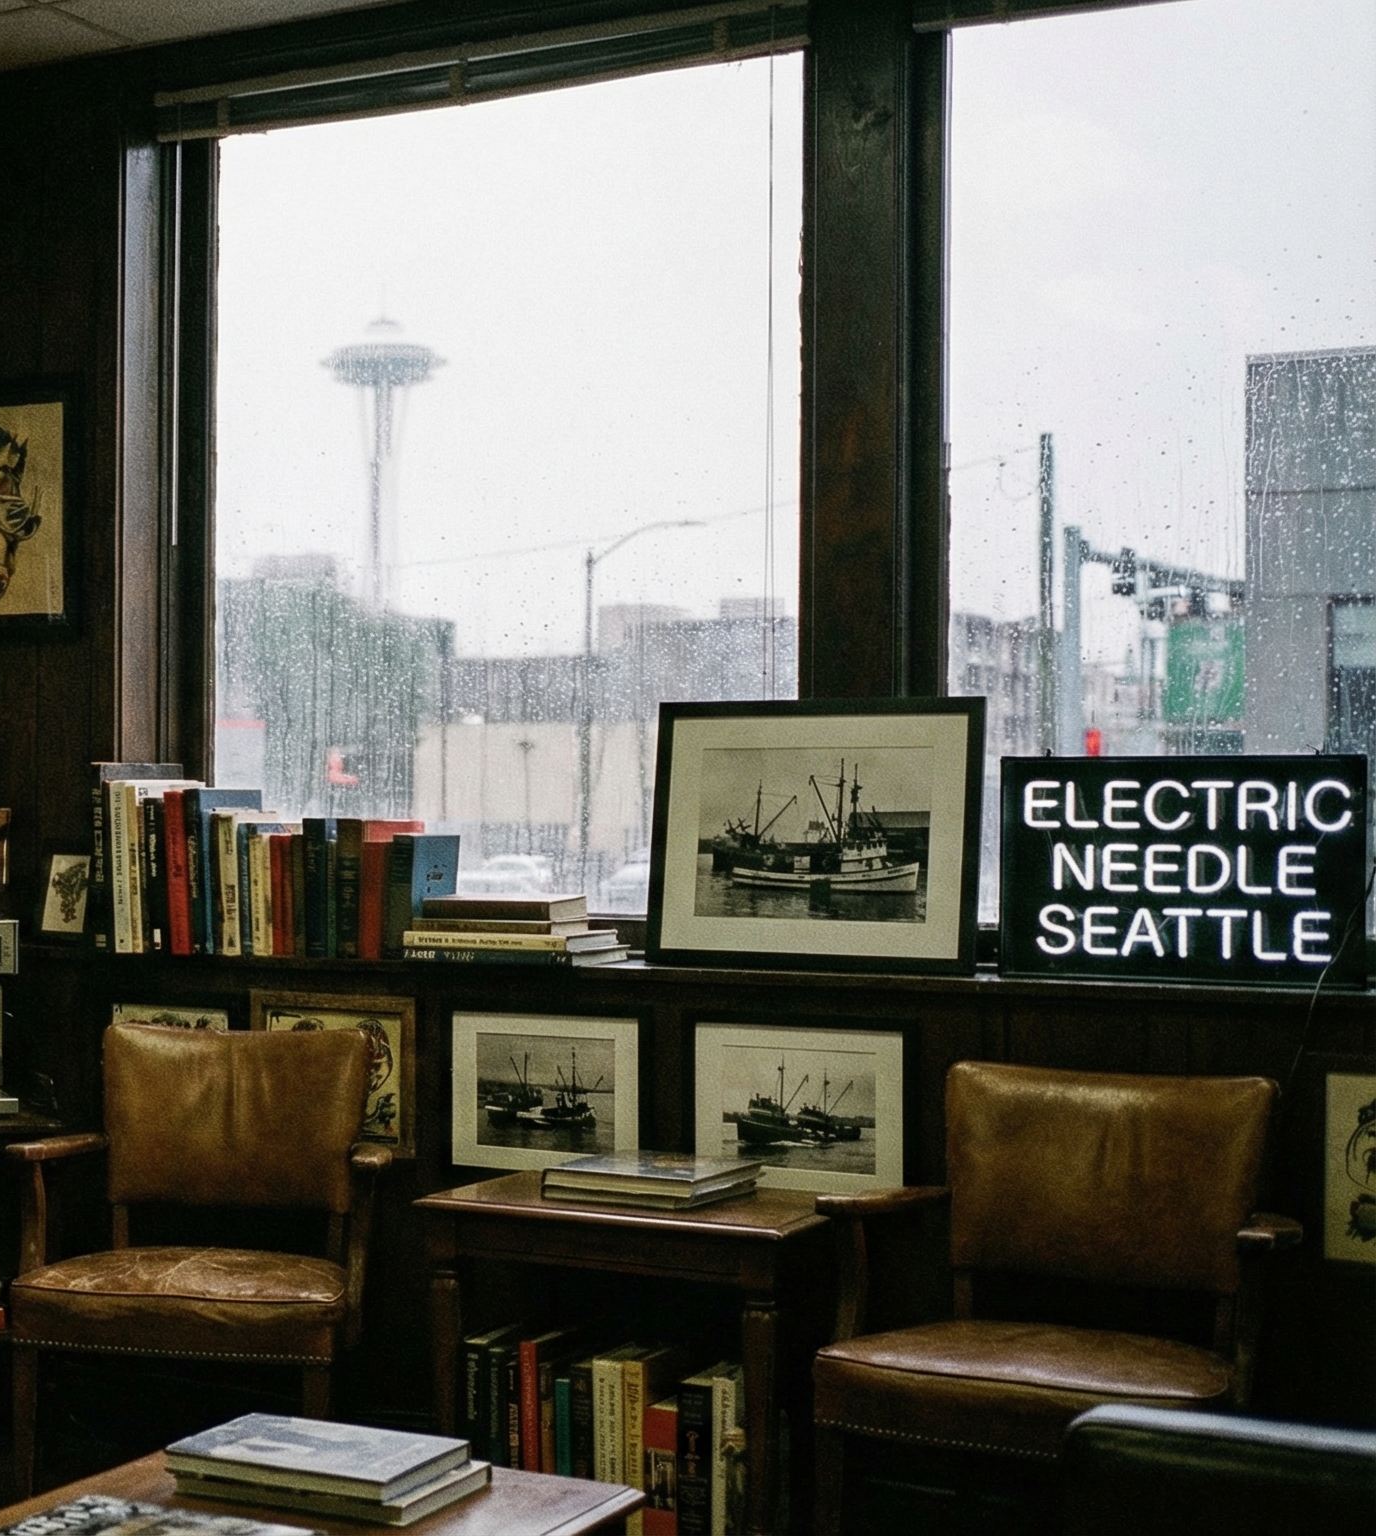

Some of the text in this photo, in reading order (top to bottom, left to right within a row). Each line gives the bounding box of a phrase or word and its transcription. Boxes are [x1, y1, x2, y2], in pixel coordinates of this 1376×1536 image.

[1024, 779, 1352, 832] ELECTRIC
[1052, 842, 1317, 896] NEEDLE
[1035, 903, 1332, 963] SEATTLE
